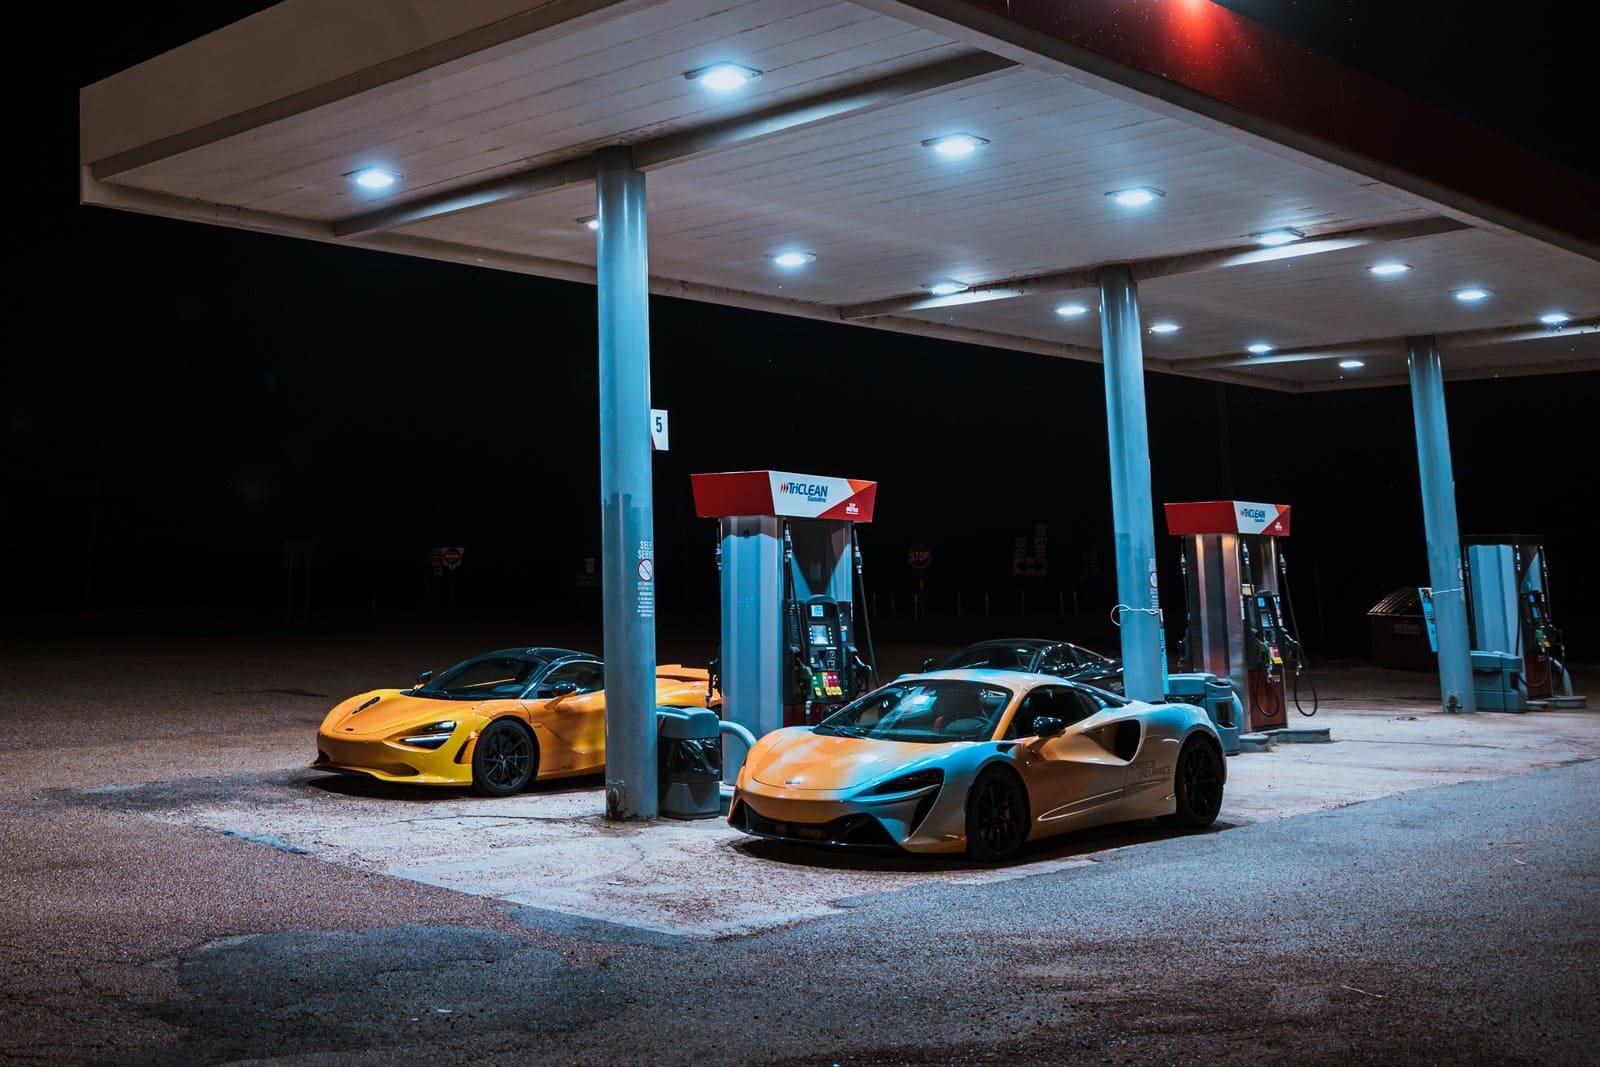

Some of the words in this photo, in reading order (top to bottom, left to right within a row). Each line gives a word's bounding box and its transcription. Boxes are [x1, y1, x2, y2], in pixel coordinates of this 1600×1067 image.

[656, 416, 663, 433] 5
[788, 482, 828, 497] TriCLEAN
[911, 551, 929, 561] STOP
